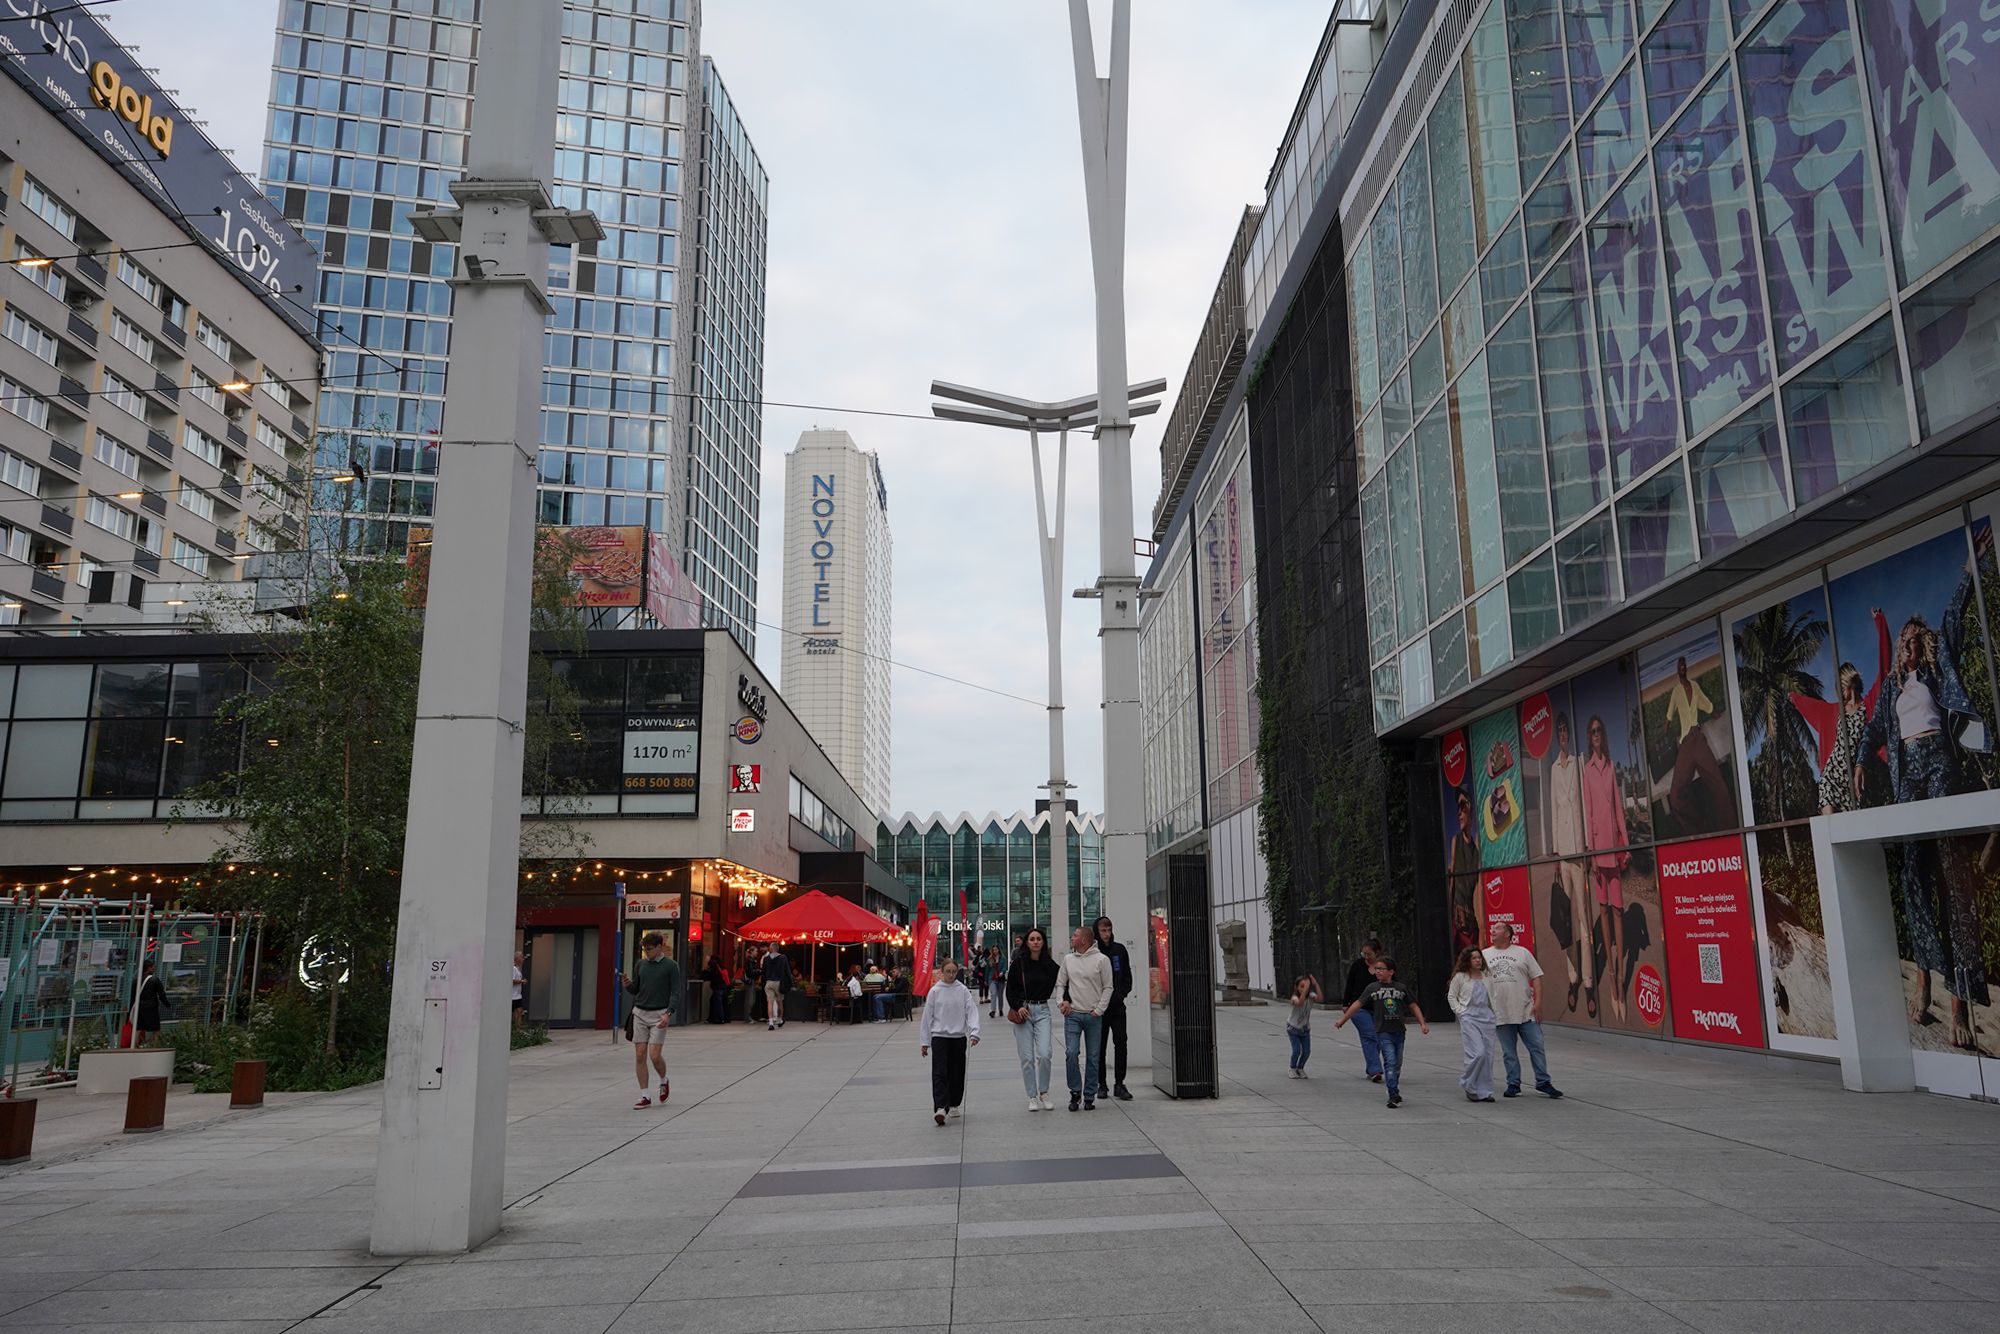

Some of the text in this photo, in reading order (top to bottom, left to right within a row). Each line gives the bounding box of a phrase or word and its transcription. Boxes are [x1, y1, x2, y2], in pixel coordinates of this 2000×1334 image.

[46, 76, 86, 120] HalfPrice
[90, 61, 174, 160] gold
[112, 138, 164, 191] BOARDRIDERS
[239, 198, 286, 251] cashback
[215, 209, 282, 299] 10%
[811, 474, 835, 627] NOVOTEL
[610, 591, 631, 600] Hut
[627, 718, 642, 727] DO
[738, 721, 758, 731] BURGER
[738, 726, 759, 737] KING
[633, 746, 669, 759] 1170
[624, 777, 695, 788] 668 500 880
[1662, 856, 1742, 878] DOŁĄCZ DO NAS!
[980, 920, 1004, 931] olski
[813, 930, 833, 938] LECH
[431, 961, 447, 971] S7
[1638, 988, 1661, 1013] 60%
